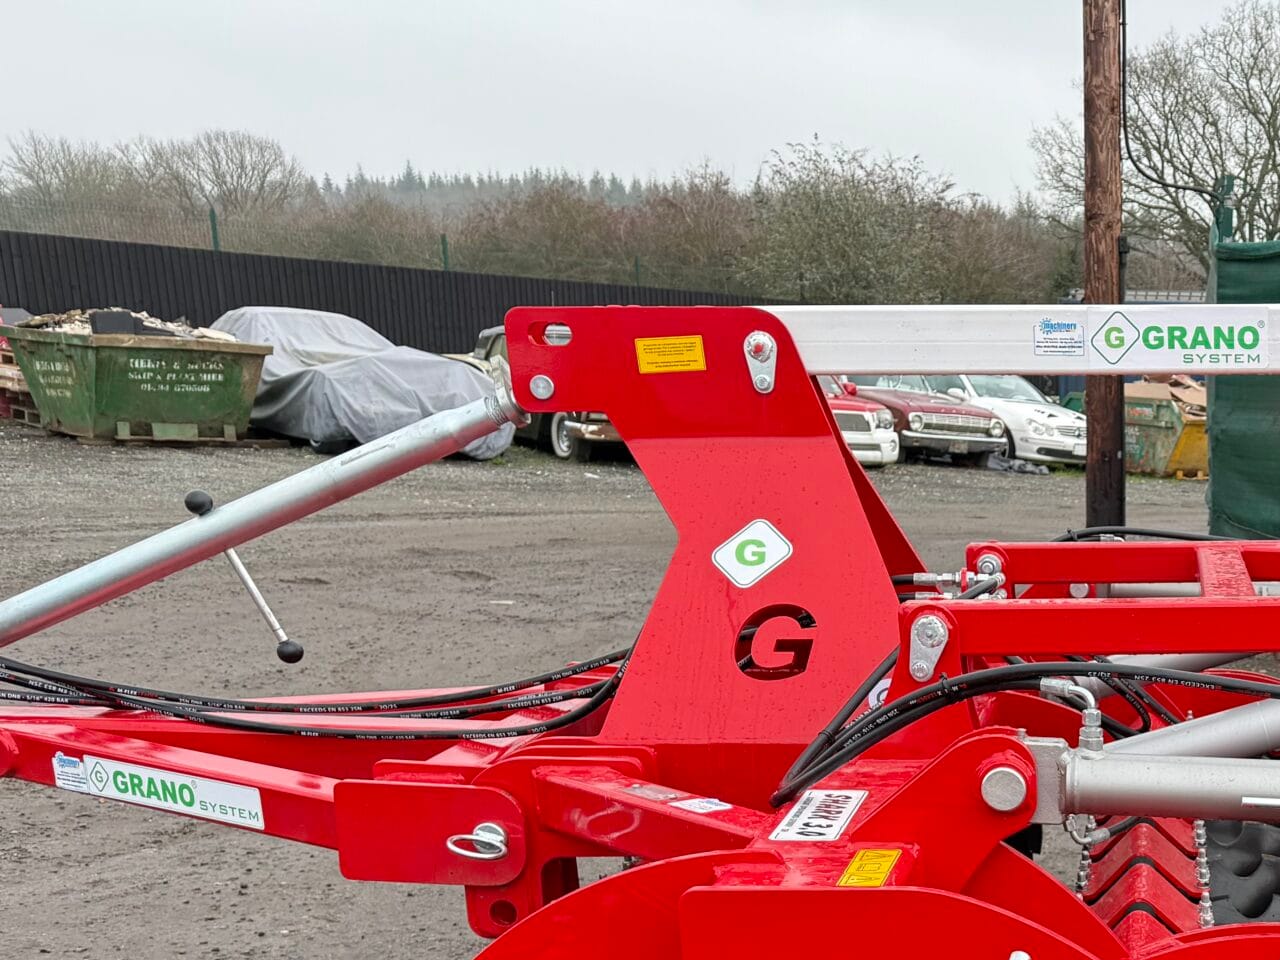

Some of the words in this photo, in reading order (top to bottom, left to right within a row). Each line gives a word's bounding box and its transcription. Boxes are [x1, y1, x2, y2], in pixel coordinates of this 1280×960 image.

[1104, 326, 1125, 349] G
[1141, 325, 1260, 350] GRANO
[1183, 353, 1261, 364] SYSTEM
[735, 539, 766, 567] G
[734, 603, 818, 681] G
[112, 770, 195, 808] GRANO
[199, 800, 260, 822] SYSTEM
[808, 793, 853, 821] SHARK
